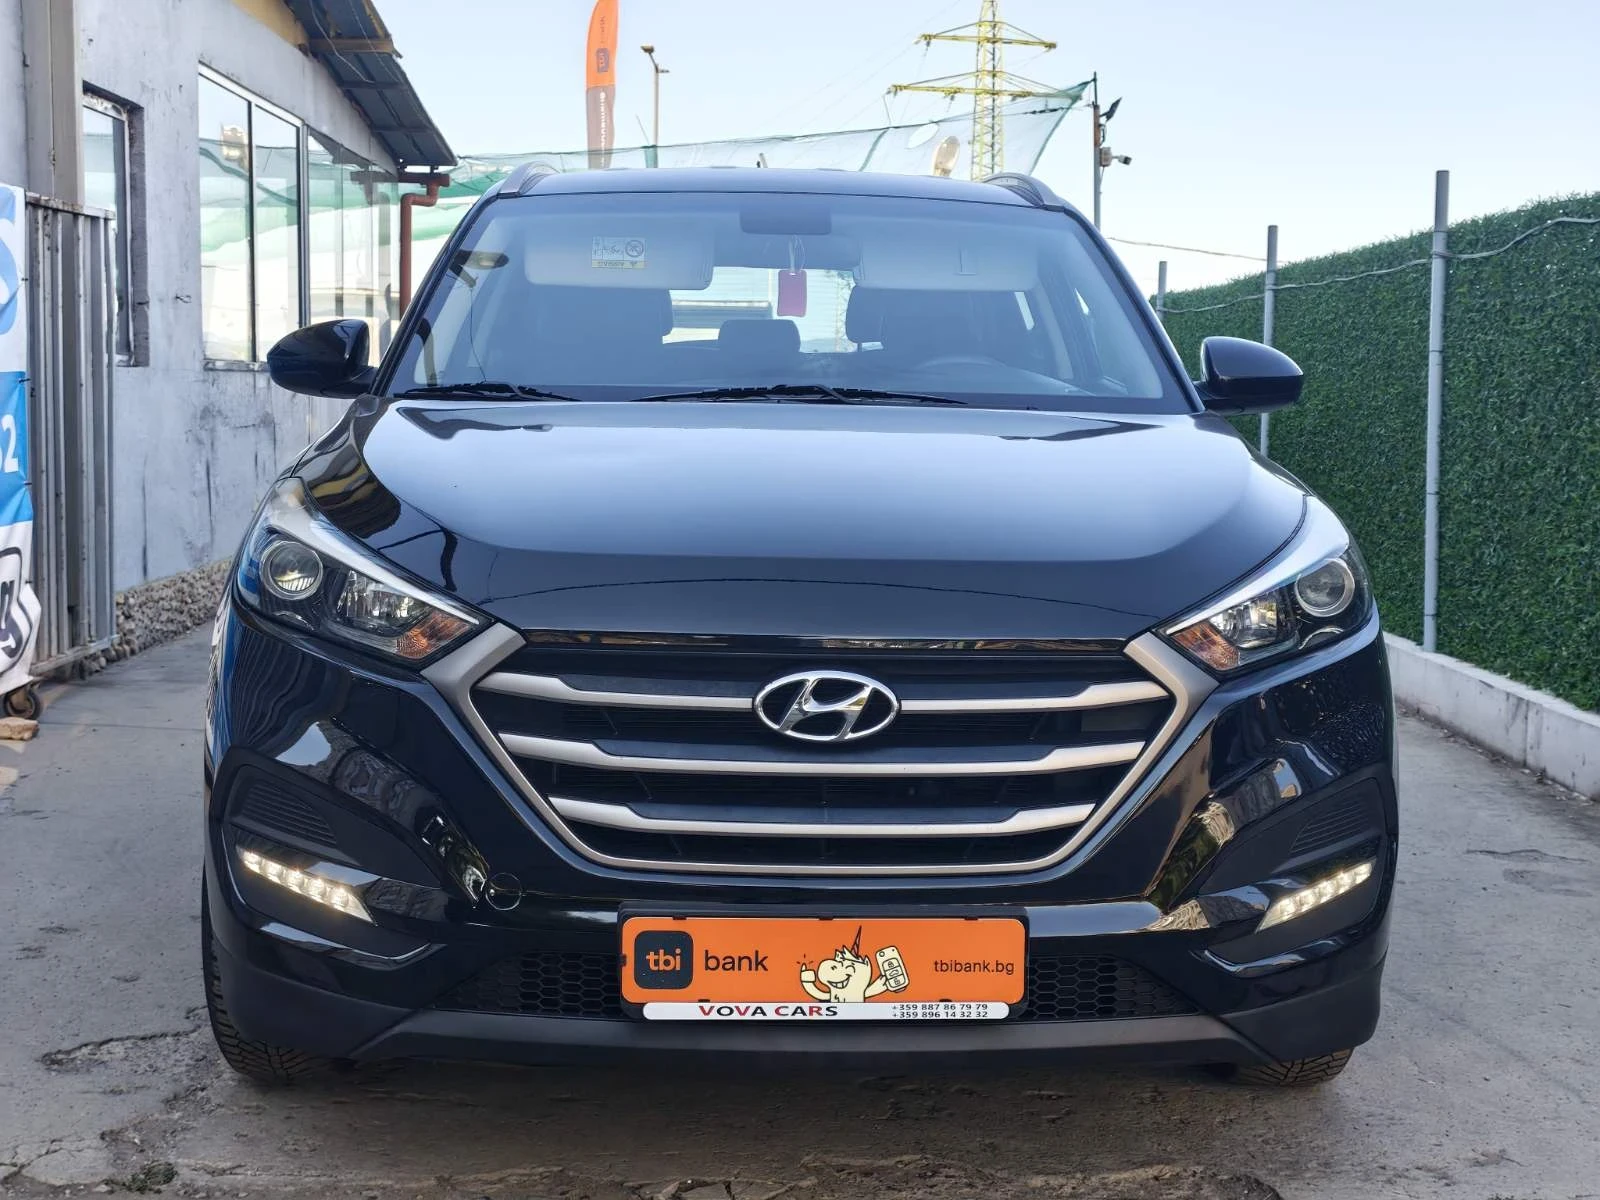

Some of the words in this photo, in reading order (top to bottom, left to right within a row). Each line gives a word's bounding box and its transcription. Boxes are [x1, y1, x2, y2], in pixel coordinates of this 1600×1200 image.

[0, 413, 19, 473] 2
[646, 948, 681, 971] tbi
[704, 949, 769, 972] bank
[934, 960, 1015, 976] tbibank.bg
[699, 1005, 767, 1017] VOVA
[774, 1005, 838, 1017] CARS
[921, 1003, 940, 1011] 887
[943, 1003, 957, 1011] 86
[959, 1003, 972, 1011] 79
[975, 1003, 988, 1011] 79
